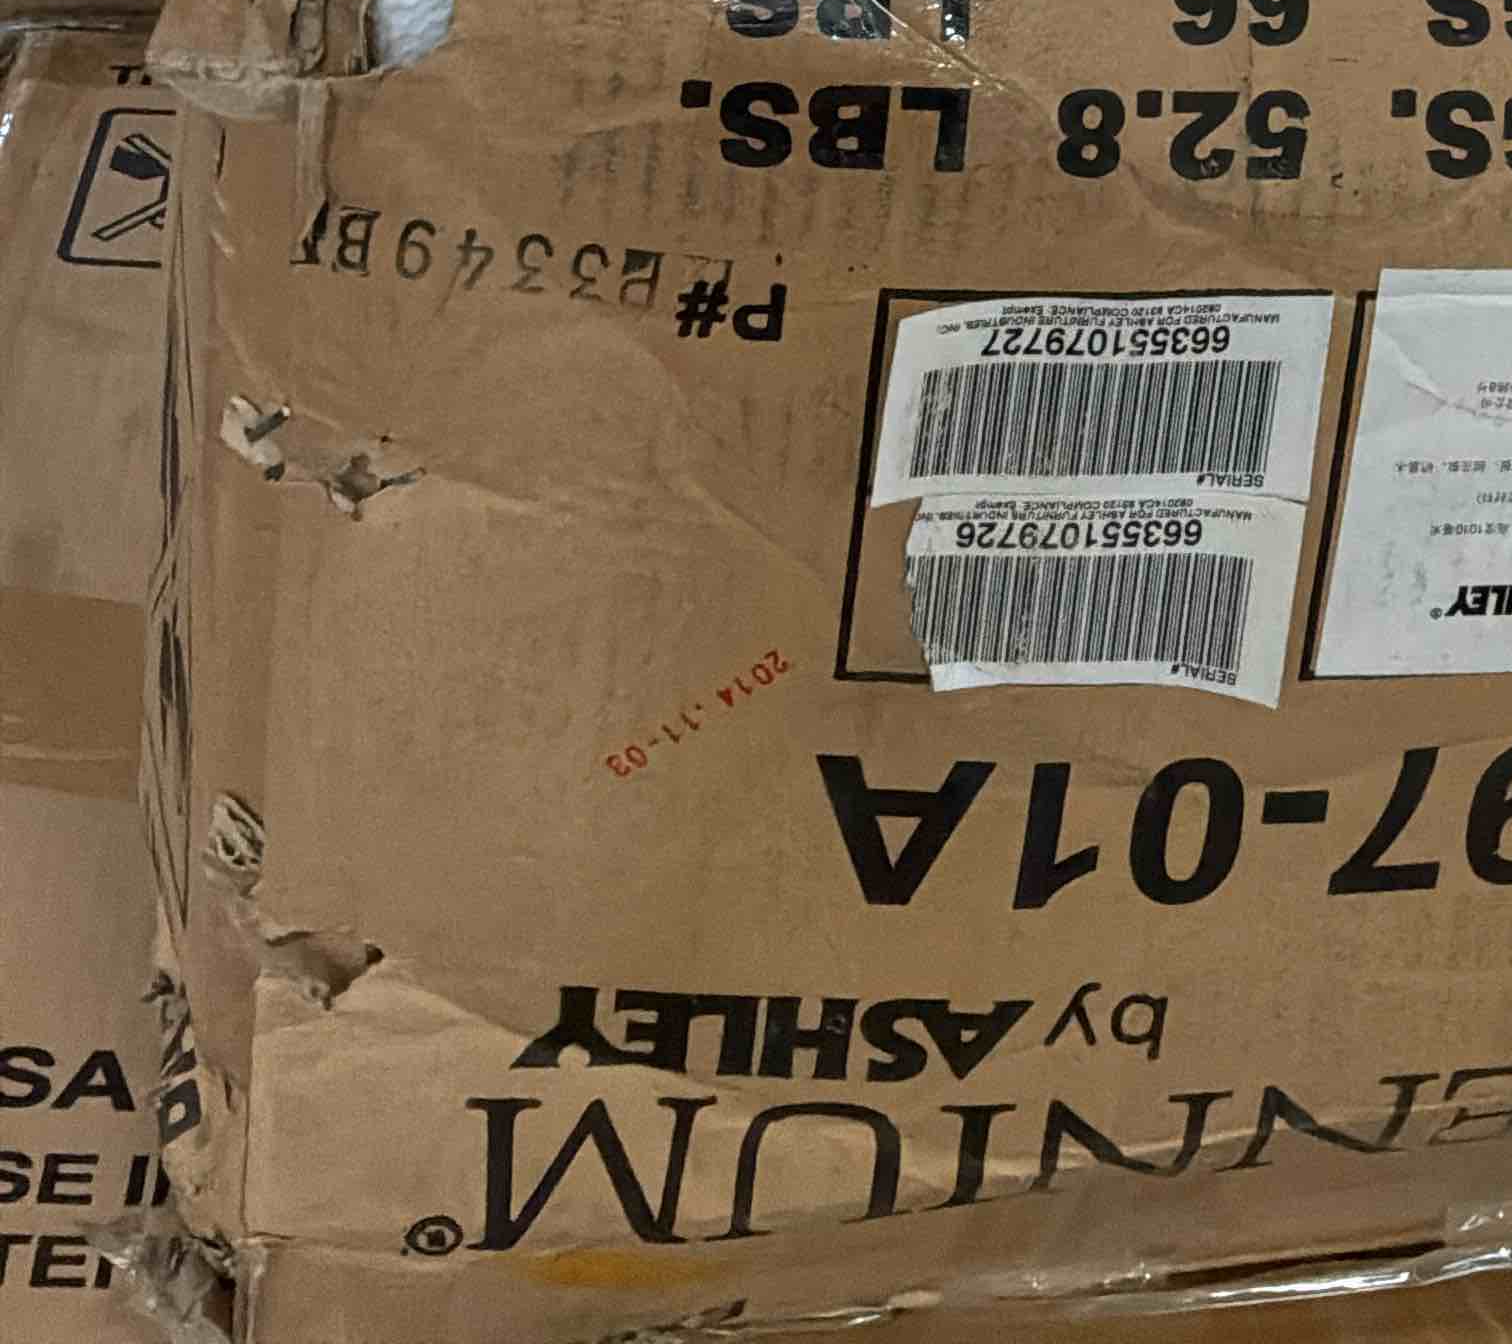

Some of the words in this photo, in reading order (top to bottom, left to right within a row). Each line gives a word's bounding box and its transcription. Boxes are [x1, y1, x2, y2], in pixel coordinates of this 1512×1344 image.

[680, 79, 971, 173] LBS.
[1055, 88, 1312, 182] 52.8
[674, 280, 788, 343] P#
[981, 325, 1231, 357] 663551079727
[955, 519, 1203, 550] 663551079726
[510, 985, 1035, 1083] ASHLEY
[1043, 981, 1169, 1061] by
